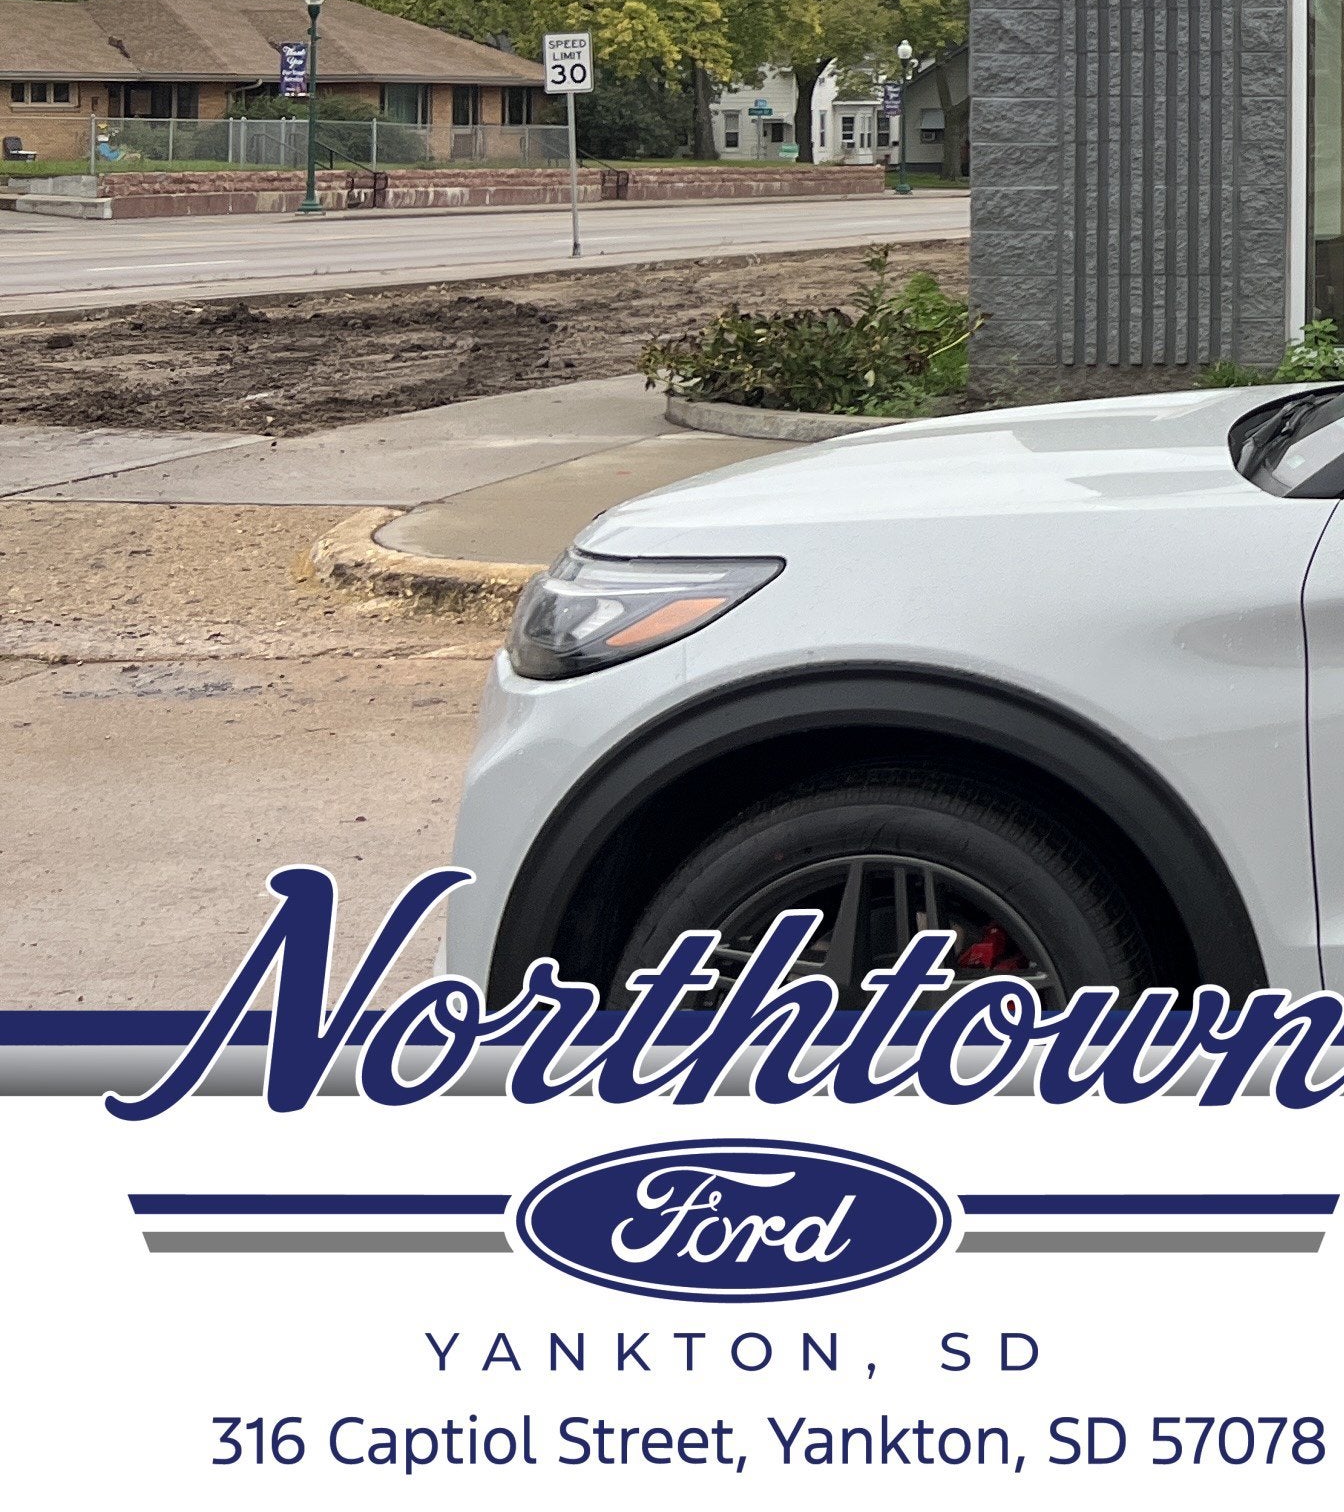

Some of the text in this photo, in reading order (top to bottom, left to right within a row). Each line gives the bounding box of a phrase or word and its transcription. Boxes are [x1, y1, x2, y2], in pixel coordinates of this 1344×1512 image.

[548, 39, 587, 49] SPEED
[553, 51, 581, 61] LIMIT
[551, 63, 587, 85] 30
